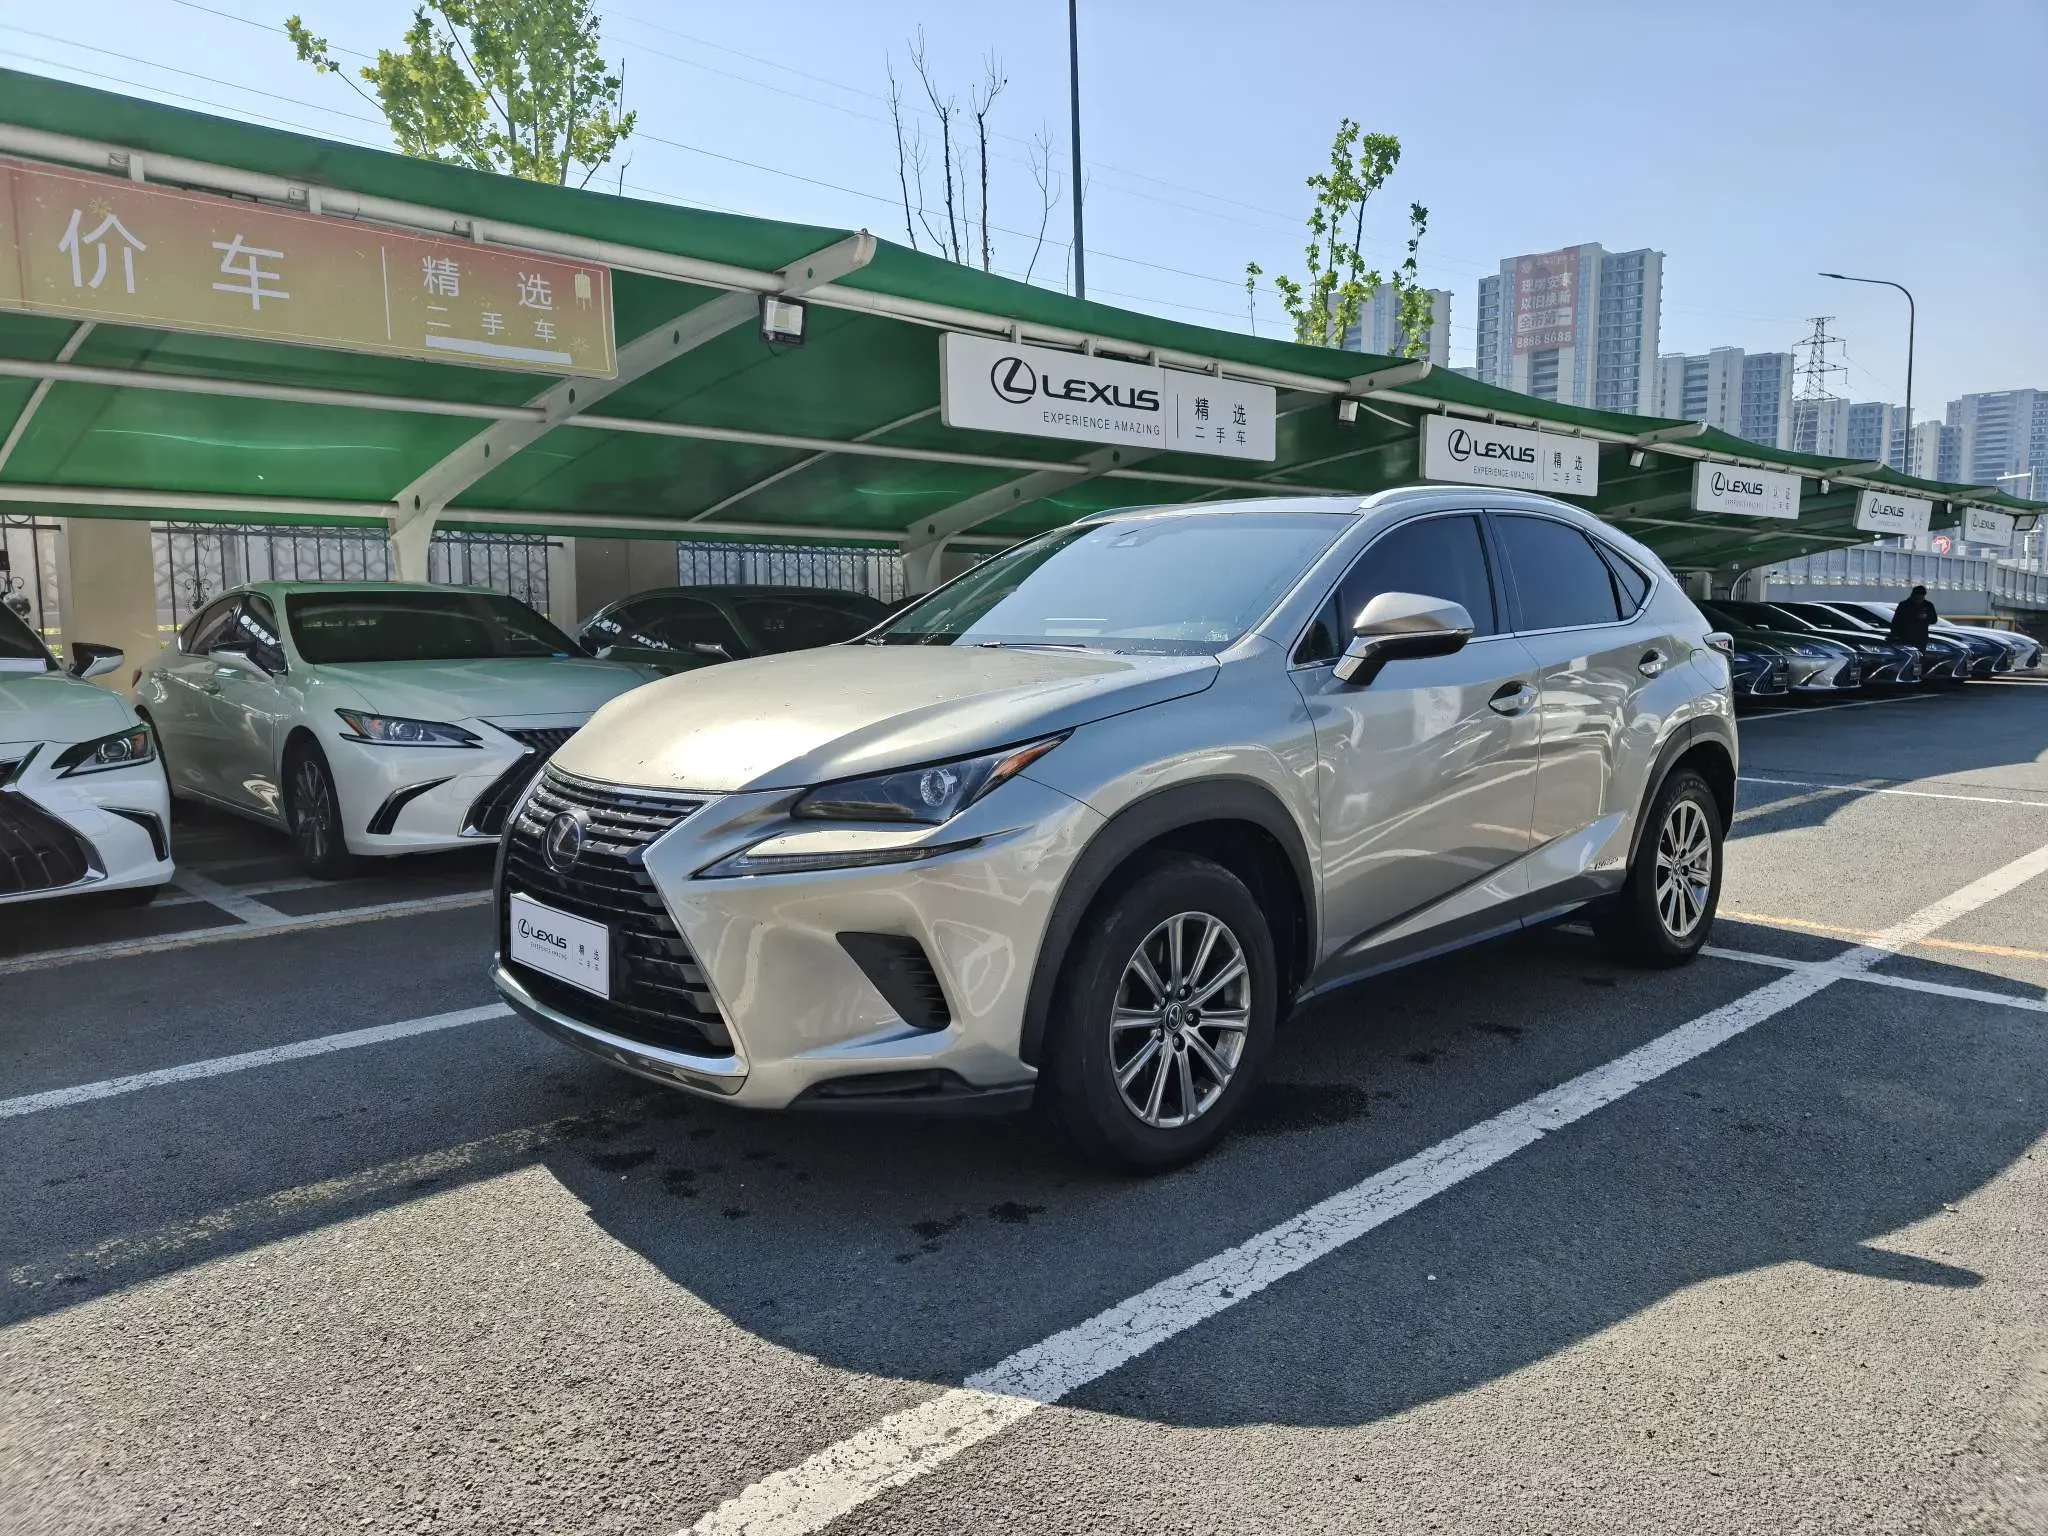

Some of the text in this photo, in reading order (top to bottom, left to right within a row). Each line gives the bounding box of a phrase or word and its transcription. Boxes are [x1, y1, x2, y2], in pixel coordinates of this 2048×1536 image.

[422, 255, 553, 310] 精选
[426, 305, 557, 343] 二手车
[1042, 374, 1160, 412] LEXUS
[1043, 411, 1160, 436] EXPERIENCE AMAZING
[1194, 397, 1247, 426] 精选
[1195, 426, 1247, 446] 二手车
[1473, 439, 1535, 464] LEXUS
[1473, 465, 1509, 478] EXPERIENCE
[1726, 479, 1764, 496] LEXUS
[1879, 504, 1905, 518] LEXUS
[530, 926, 567, 950] LEXUS
